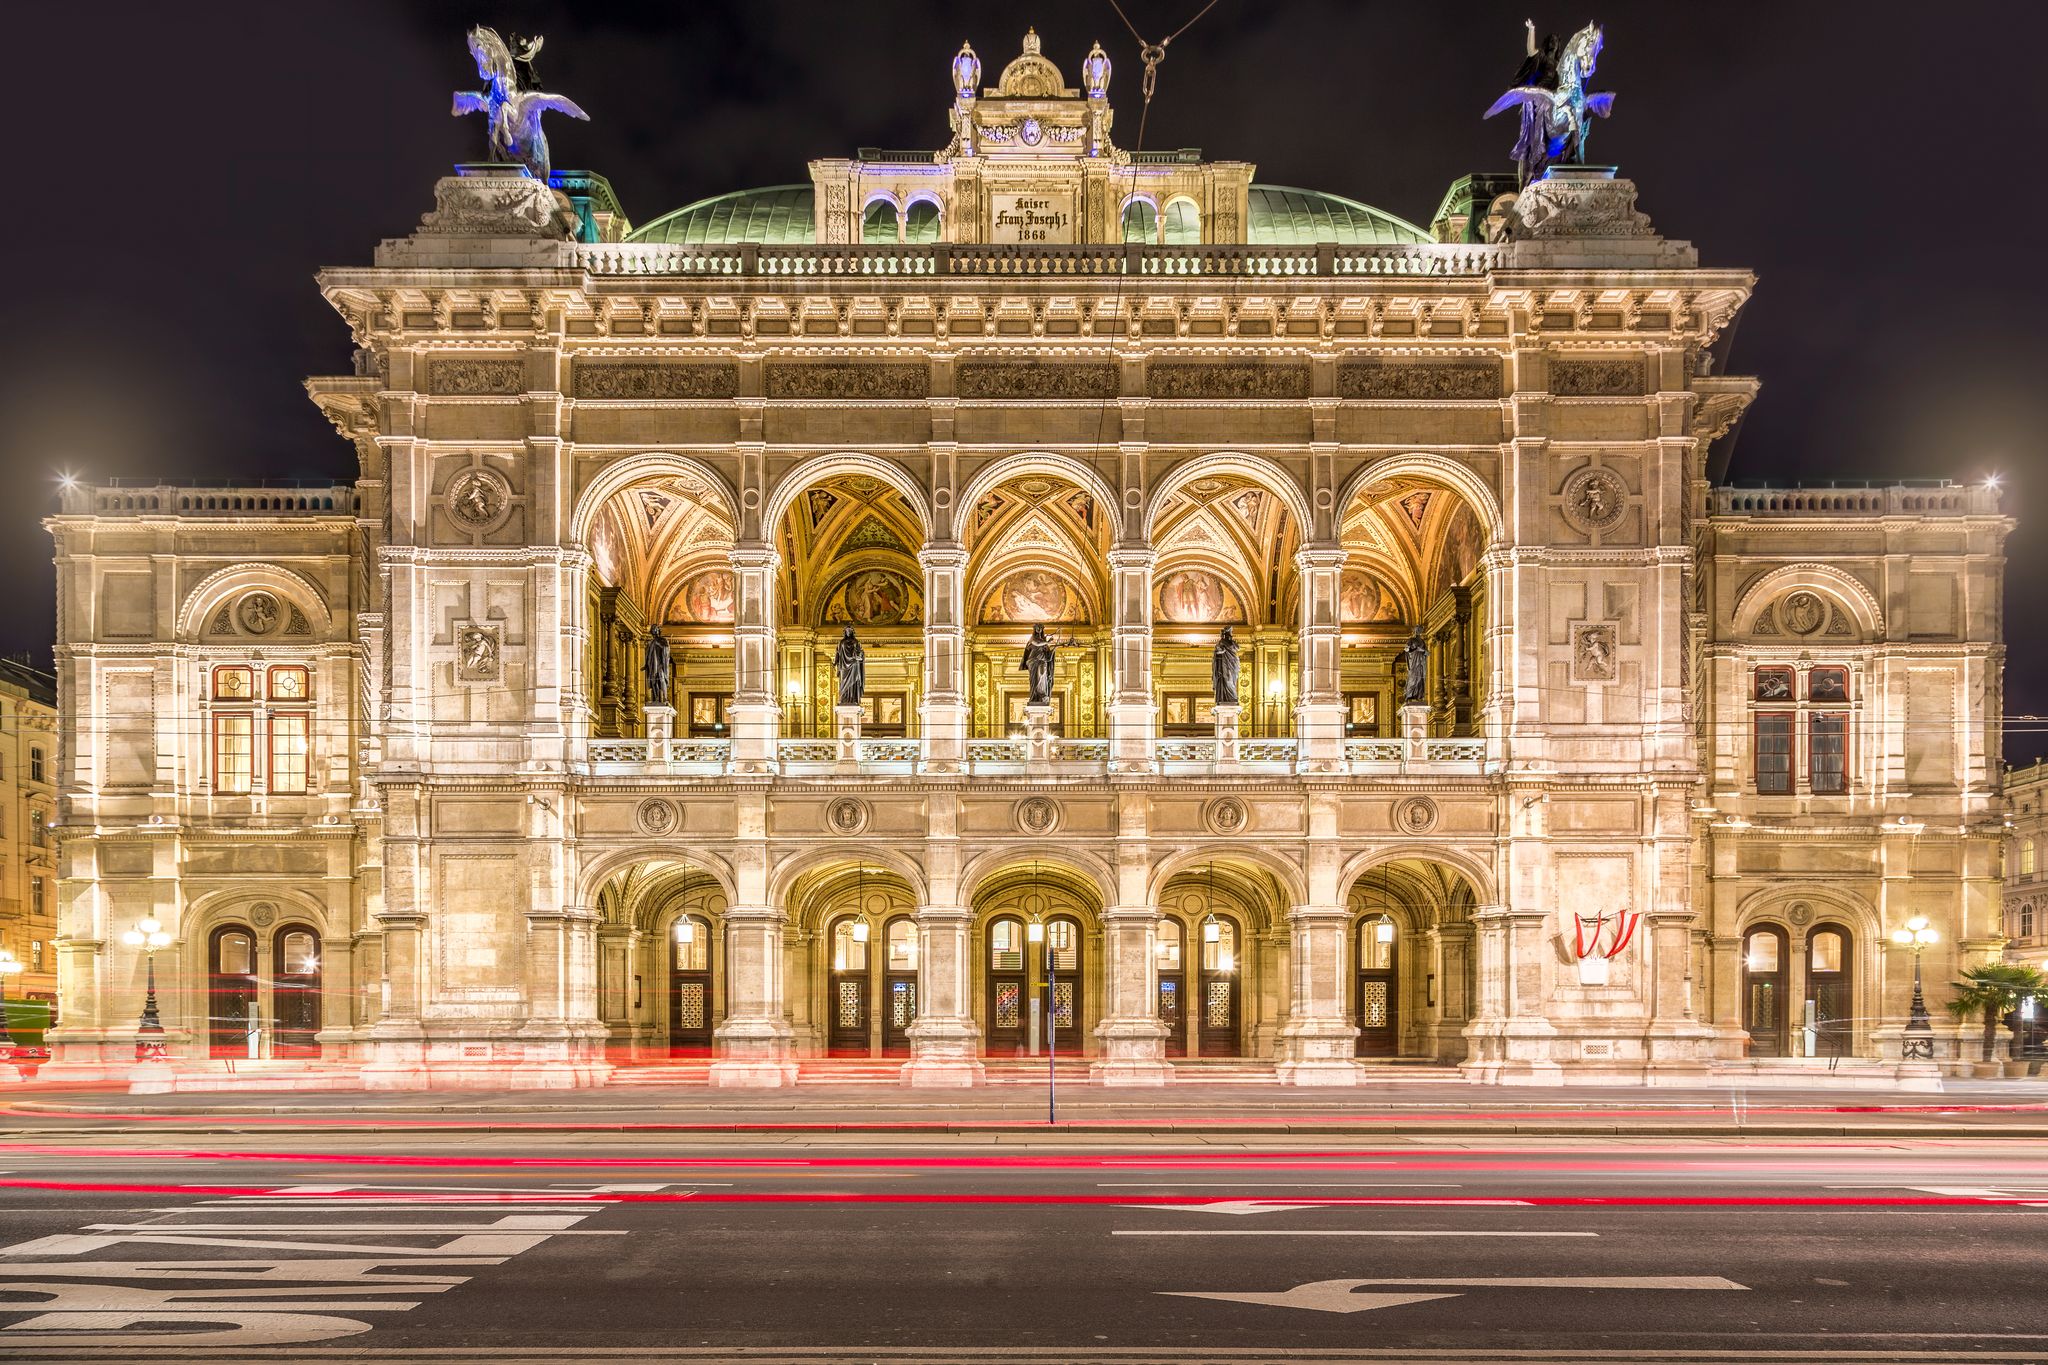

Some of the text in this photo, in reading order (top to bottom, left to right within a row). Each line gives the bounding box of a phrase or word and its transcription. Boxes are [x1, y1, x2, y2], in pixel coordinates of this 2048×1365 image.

[1015, 198, 1049, 210] Kaiser
[995, 210, 1024, 229] Franz
[1025, 210, 1060, 230] Joseph
[1018, 230, 1046, 241] 1868
